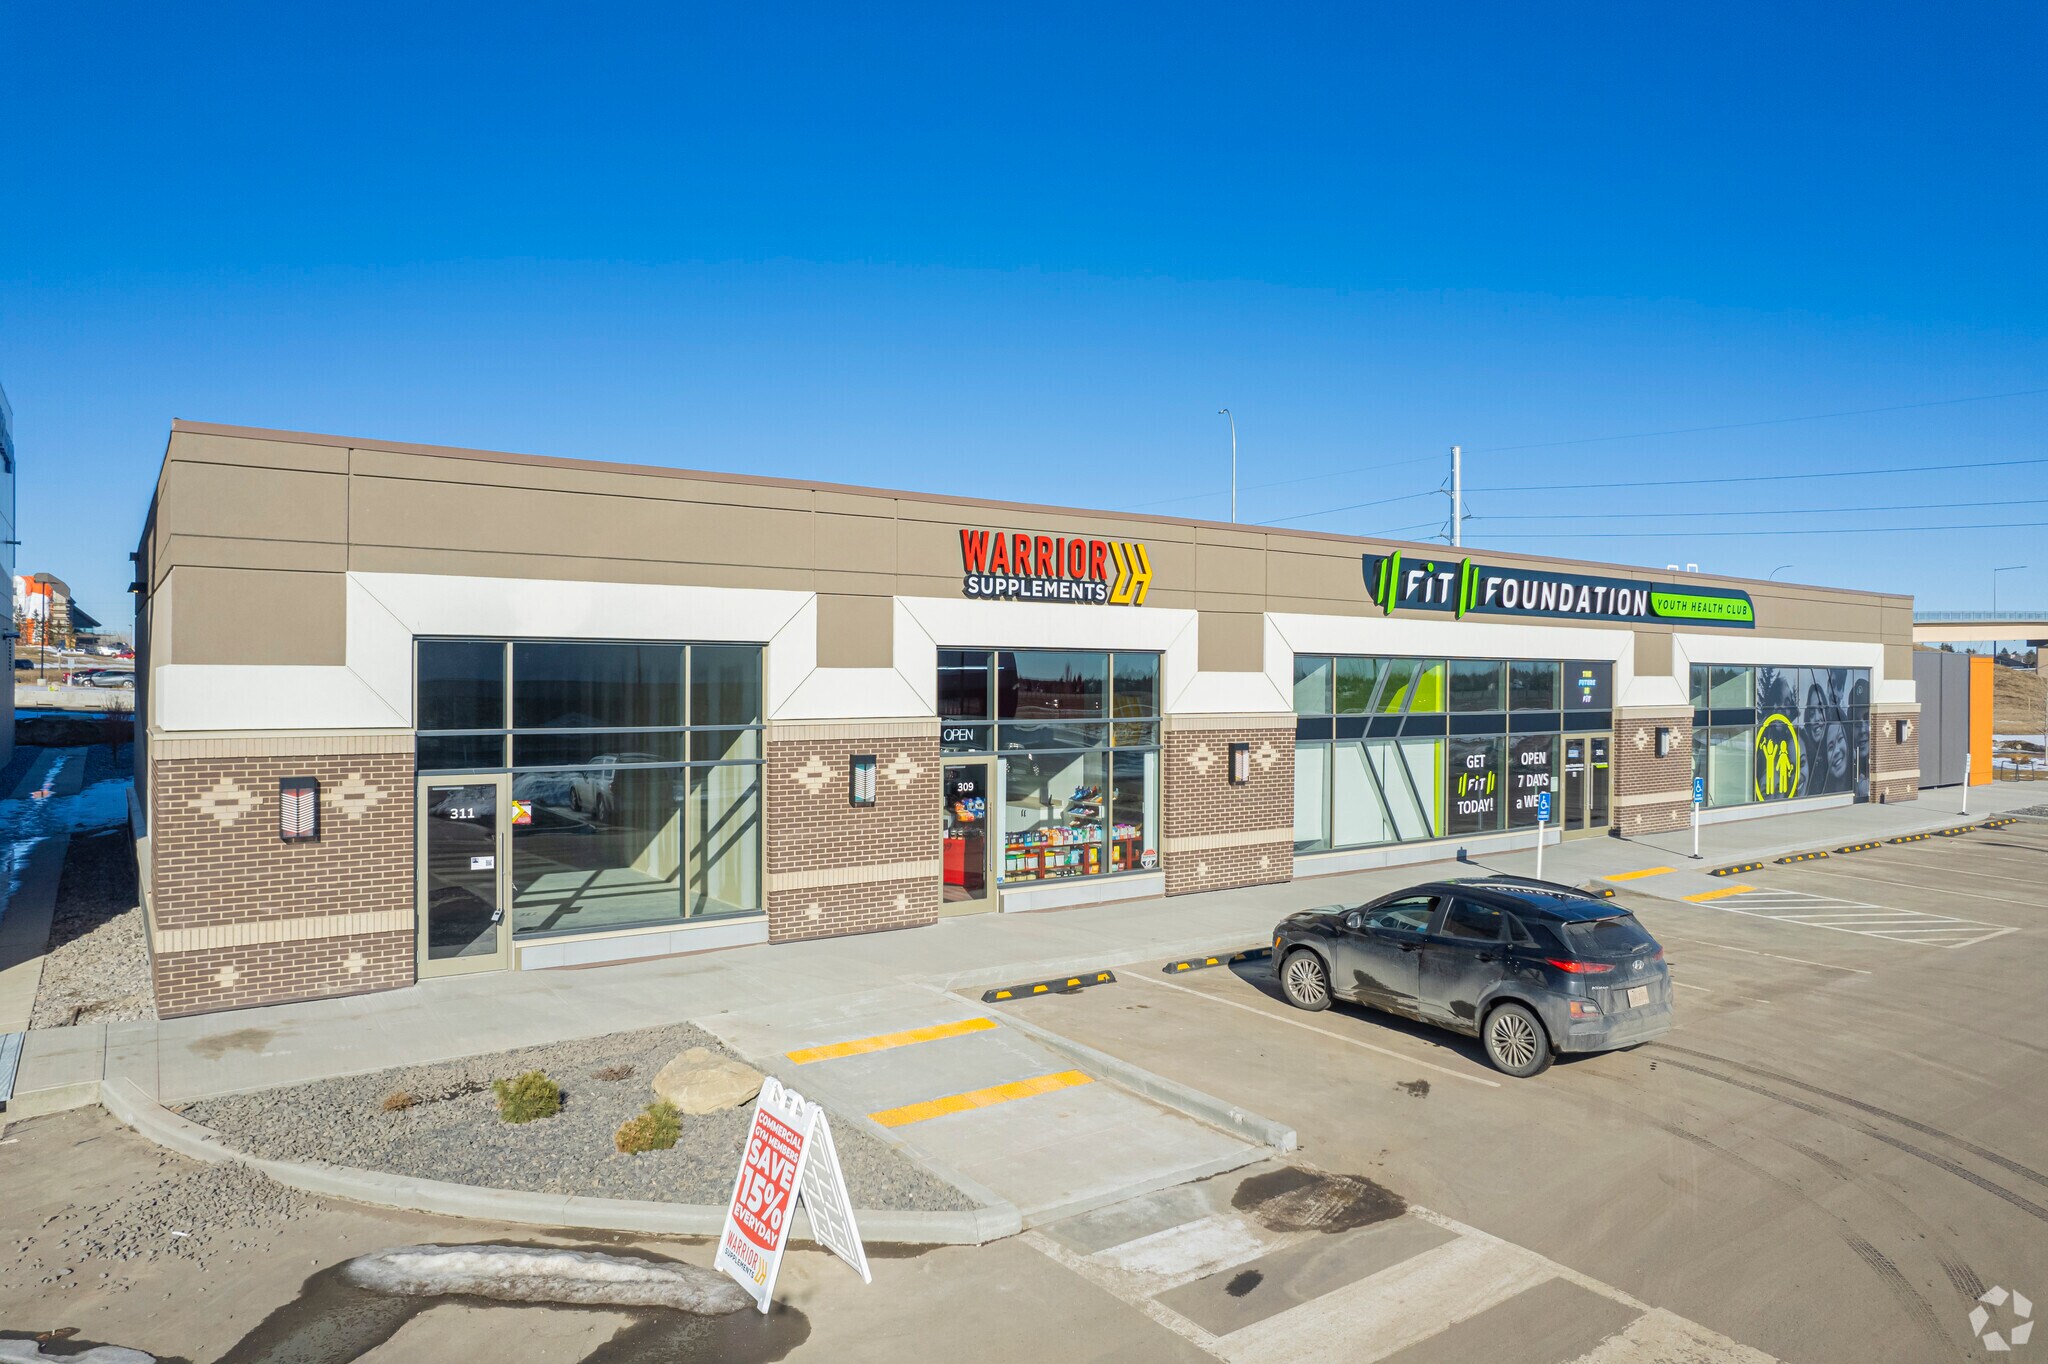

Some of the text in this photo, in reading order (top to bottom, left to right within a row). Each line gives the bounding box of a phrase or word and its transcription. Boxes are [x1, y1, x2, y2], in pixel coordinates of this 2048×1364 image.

[960, 529, 1107, 580] WARRIOR
[967, 576, 1106, 600] SUPPLEMENTS
[1484, 577, 1648, 617] FOUNDATION
[1657, 599, 1748, 615] YOUTH HEALTH CLUB
[943, 728, 974, 741] OPEN
[1466, 754, 1486, 769] GET
[1520, 751, 1547, 766] OPEN
[957, 782, 974, 792] 309
[1518, 773, 1549, 788] 7 DAYS
[449, 807, 475, 819] 311
[1458, 797, 1494, 815] TODAY!
[1516, 795, 1540, 809] a WE
[758, 1111, 802, 1150] COMMERCIAL
[754, 1126, 799, 1163] GYM MEMBERS
[748, 1139, 796, 1192] SAVE
[739, 1165, 784, 1231] 15%
[733, 1202, 779, 1247] EVERYDAY
[725, 1230, 759, 1271] WARRIOR
[724, 1247, 755, 1279] SUPPLEMENTS
